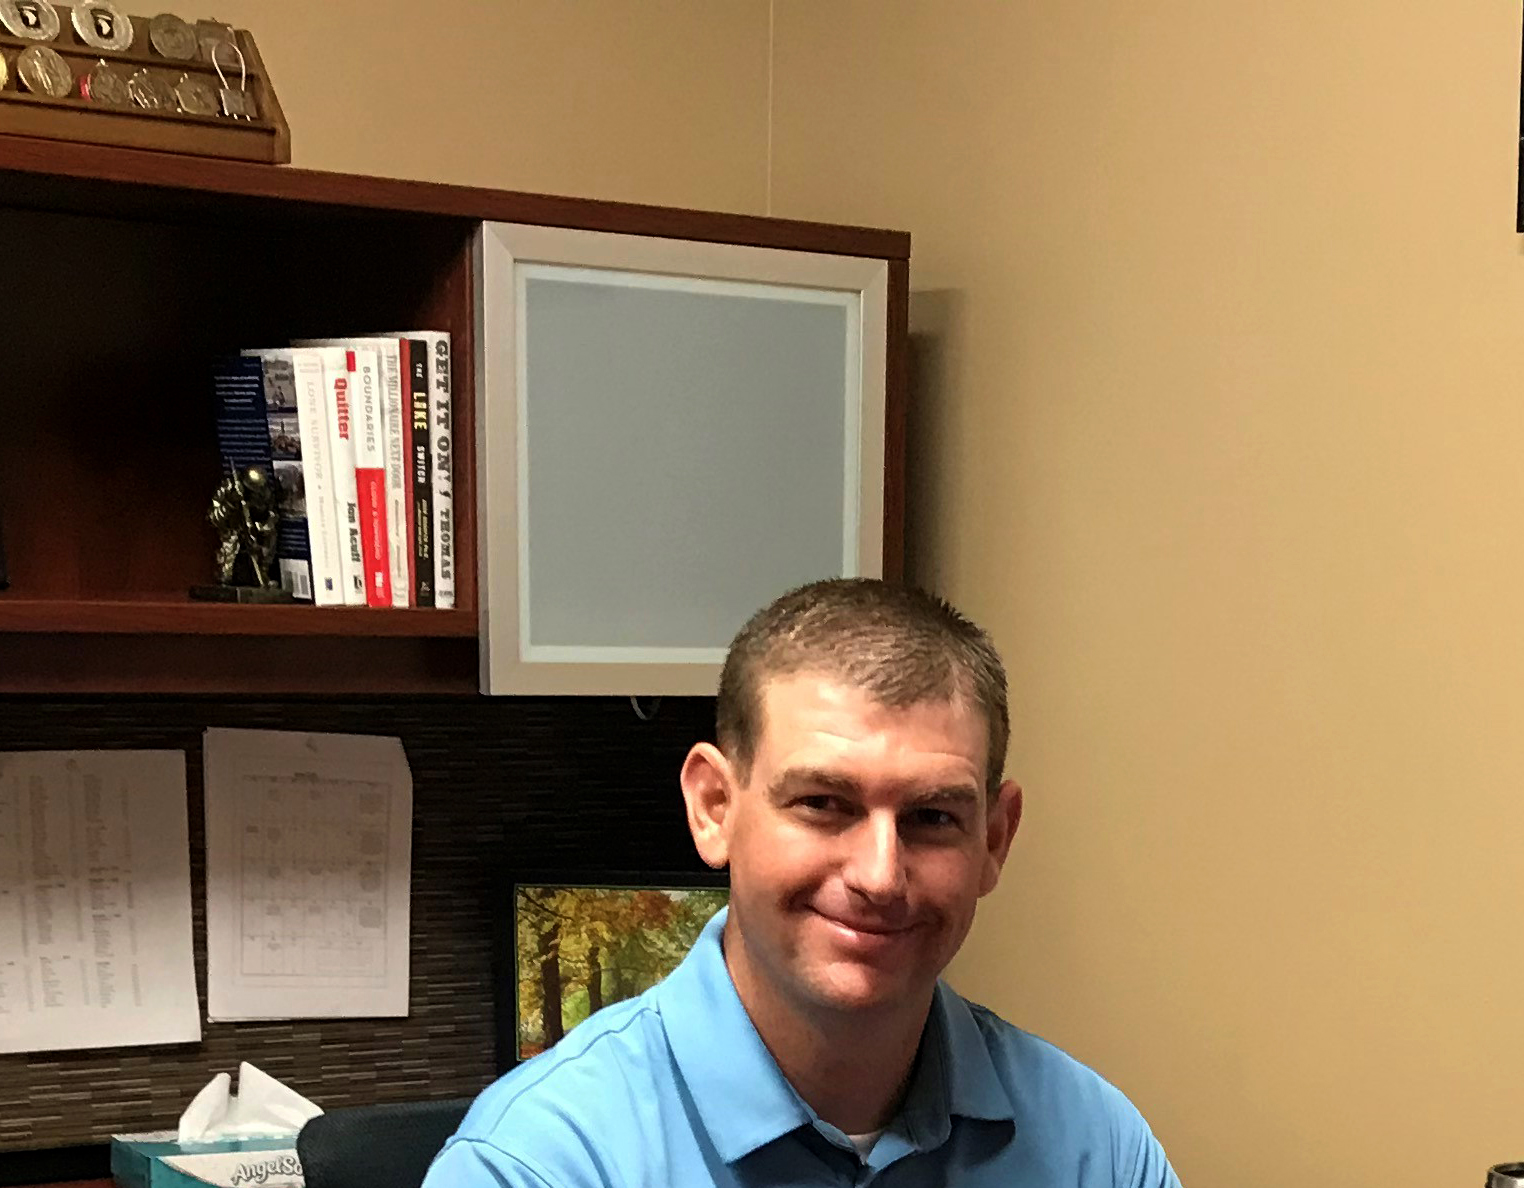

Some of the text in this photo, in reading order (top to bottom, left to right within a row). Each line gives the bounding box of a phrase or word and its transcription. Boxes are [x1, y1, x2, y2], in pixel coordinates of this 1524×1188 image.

[435, 340, 449, 393] GET
[334, 378, 350, 441] Quitter
[363, 366, 376, 452] BOUNDARIES
[436, 399, 450, 430] IT
[416, 445, 427, 484] SWITCH
[347, 502, 357, 523] Jon
[440, 508, 451, 580] THOMAS
